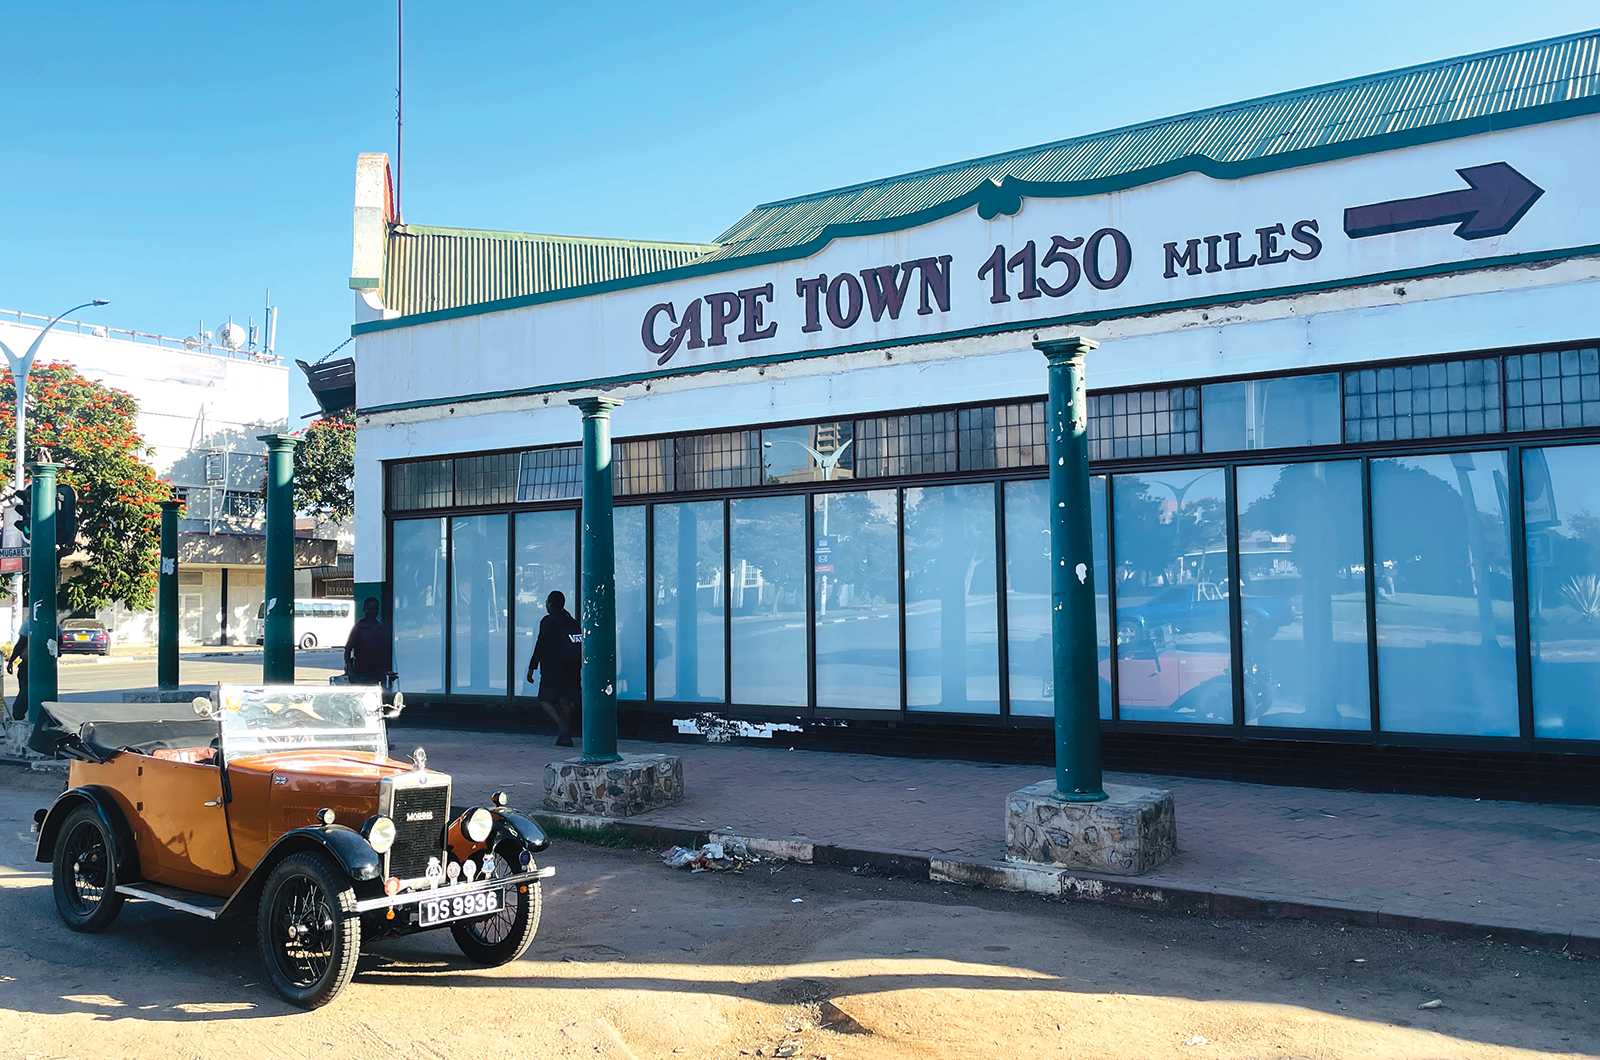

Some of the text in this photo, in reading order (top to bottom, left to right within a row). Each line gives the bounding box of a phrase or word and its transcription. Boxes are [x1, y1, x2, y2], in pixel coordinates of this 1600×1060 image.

[641, 219, 1323, 366] CAPE TOWN 1150 MILES
[406, 811, 433, 821] MORRIS
[427, 891, 498, 922] DS 9936
